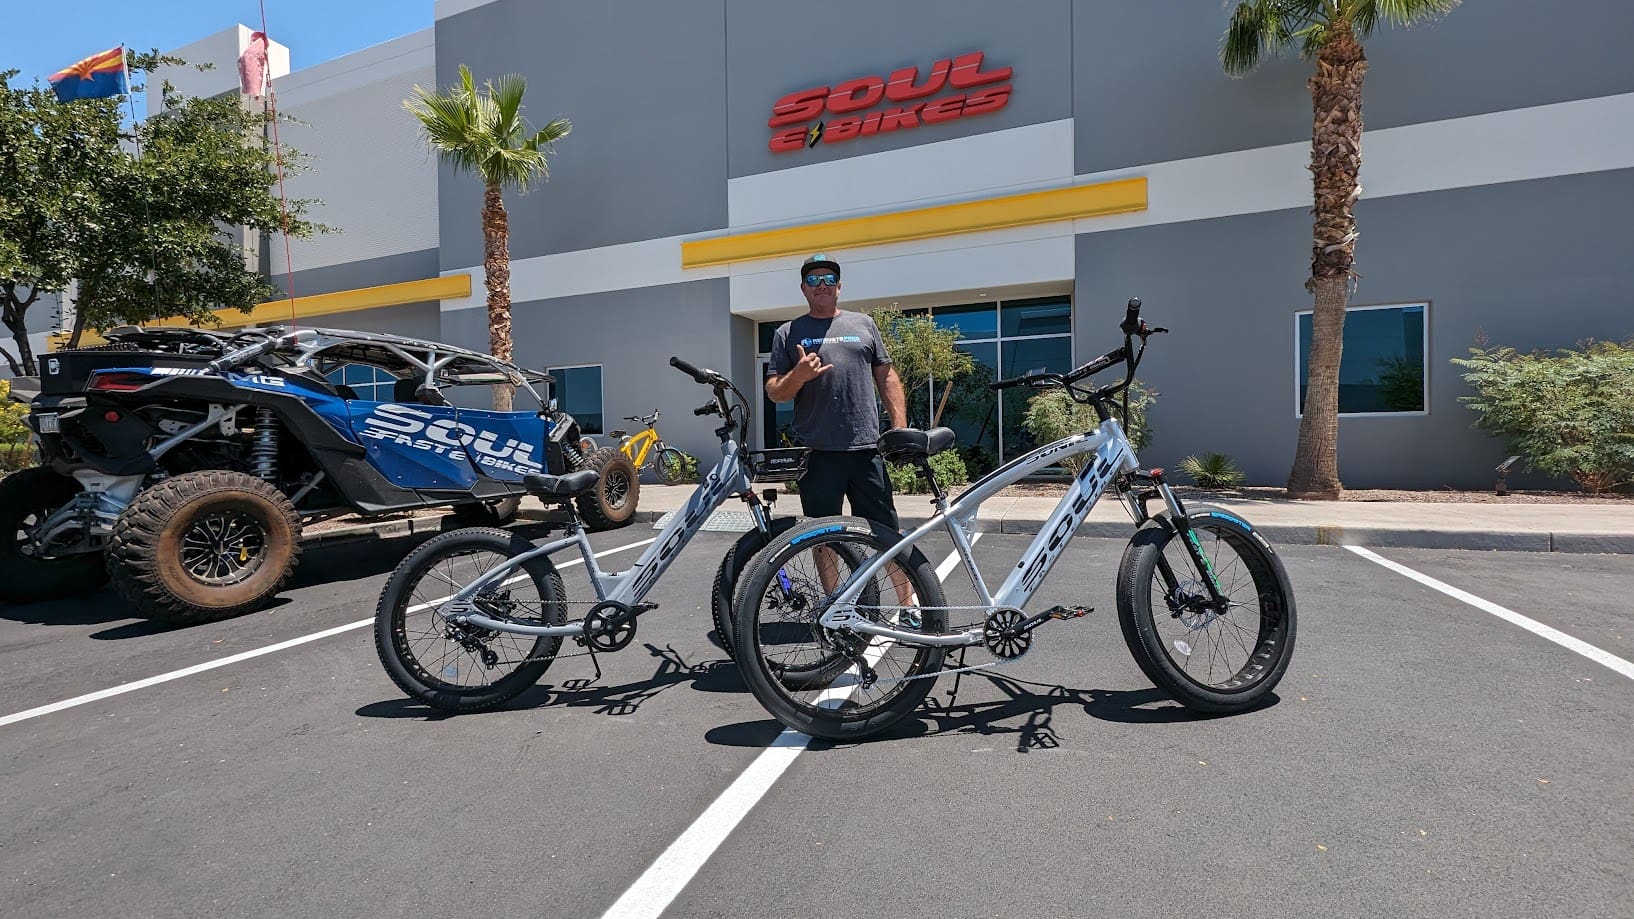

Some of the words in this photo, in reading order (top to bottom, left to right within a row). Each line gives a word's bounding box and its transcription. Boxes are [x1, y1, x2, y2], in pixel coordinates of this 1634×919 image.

[768, 51, 1013, 128] SOUL
[823, 84, 1013, 144] BIKES
[360, 427, 460, 455] FAST
[365, 403, 543, 468] SOUL
[632, 470, 738, 602] SOUL
[1022, 448, 1124, 593] SOUL
